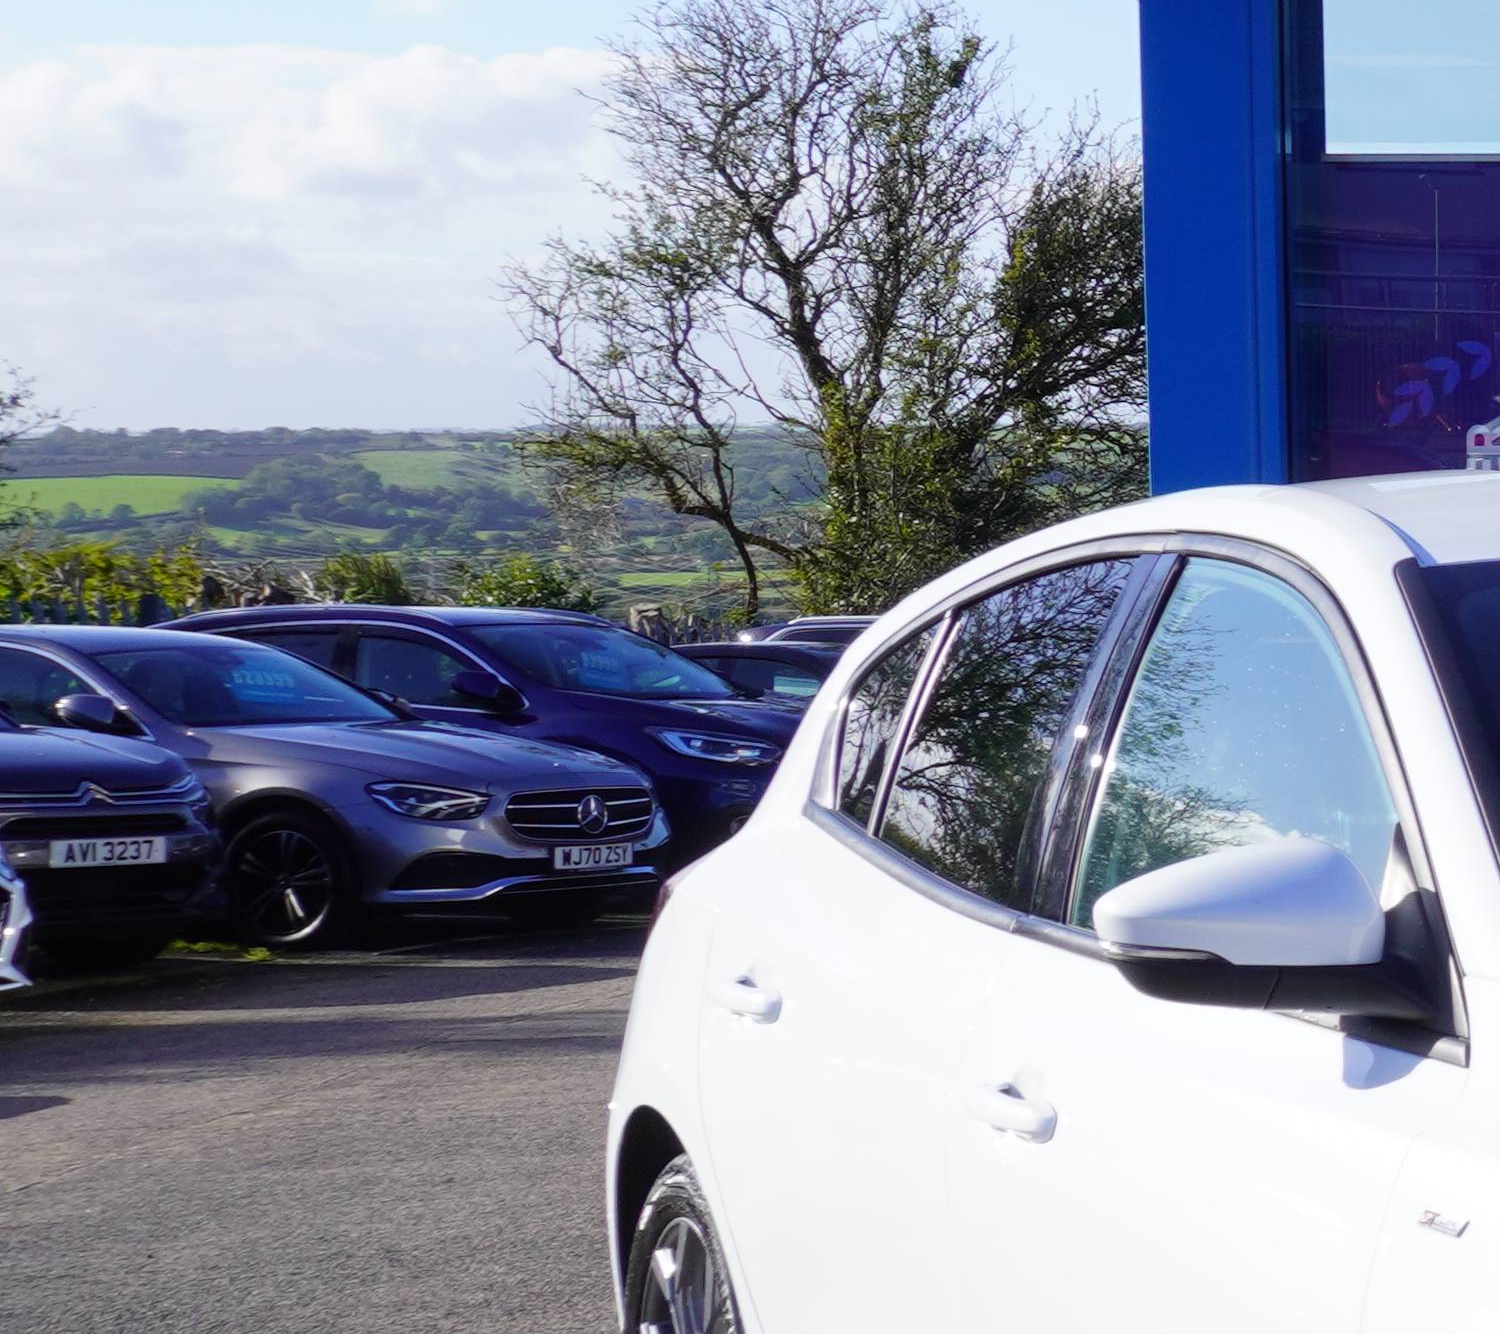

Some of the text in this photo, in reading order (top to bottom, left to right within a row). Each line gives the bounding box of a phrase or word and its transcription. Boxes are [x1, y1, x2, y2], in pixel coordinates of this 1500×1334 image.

[64, 840, 154, 863] AVI 3237
[562, 845, 627, 866] WJ70 ZSY
